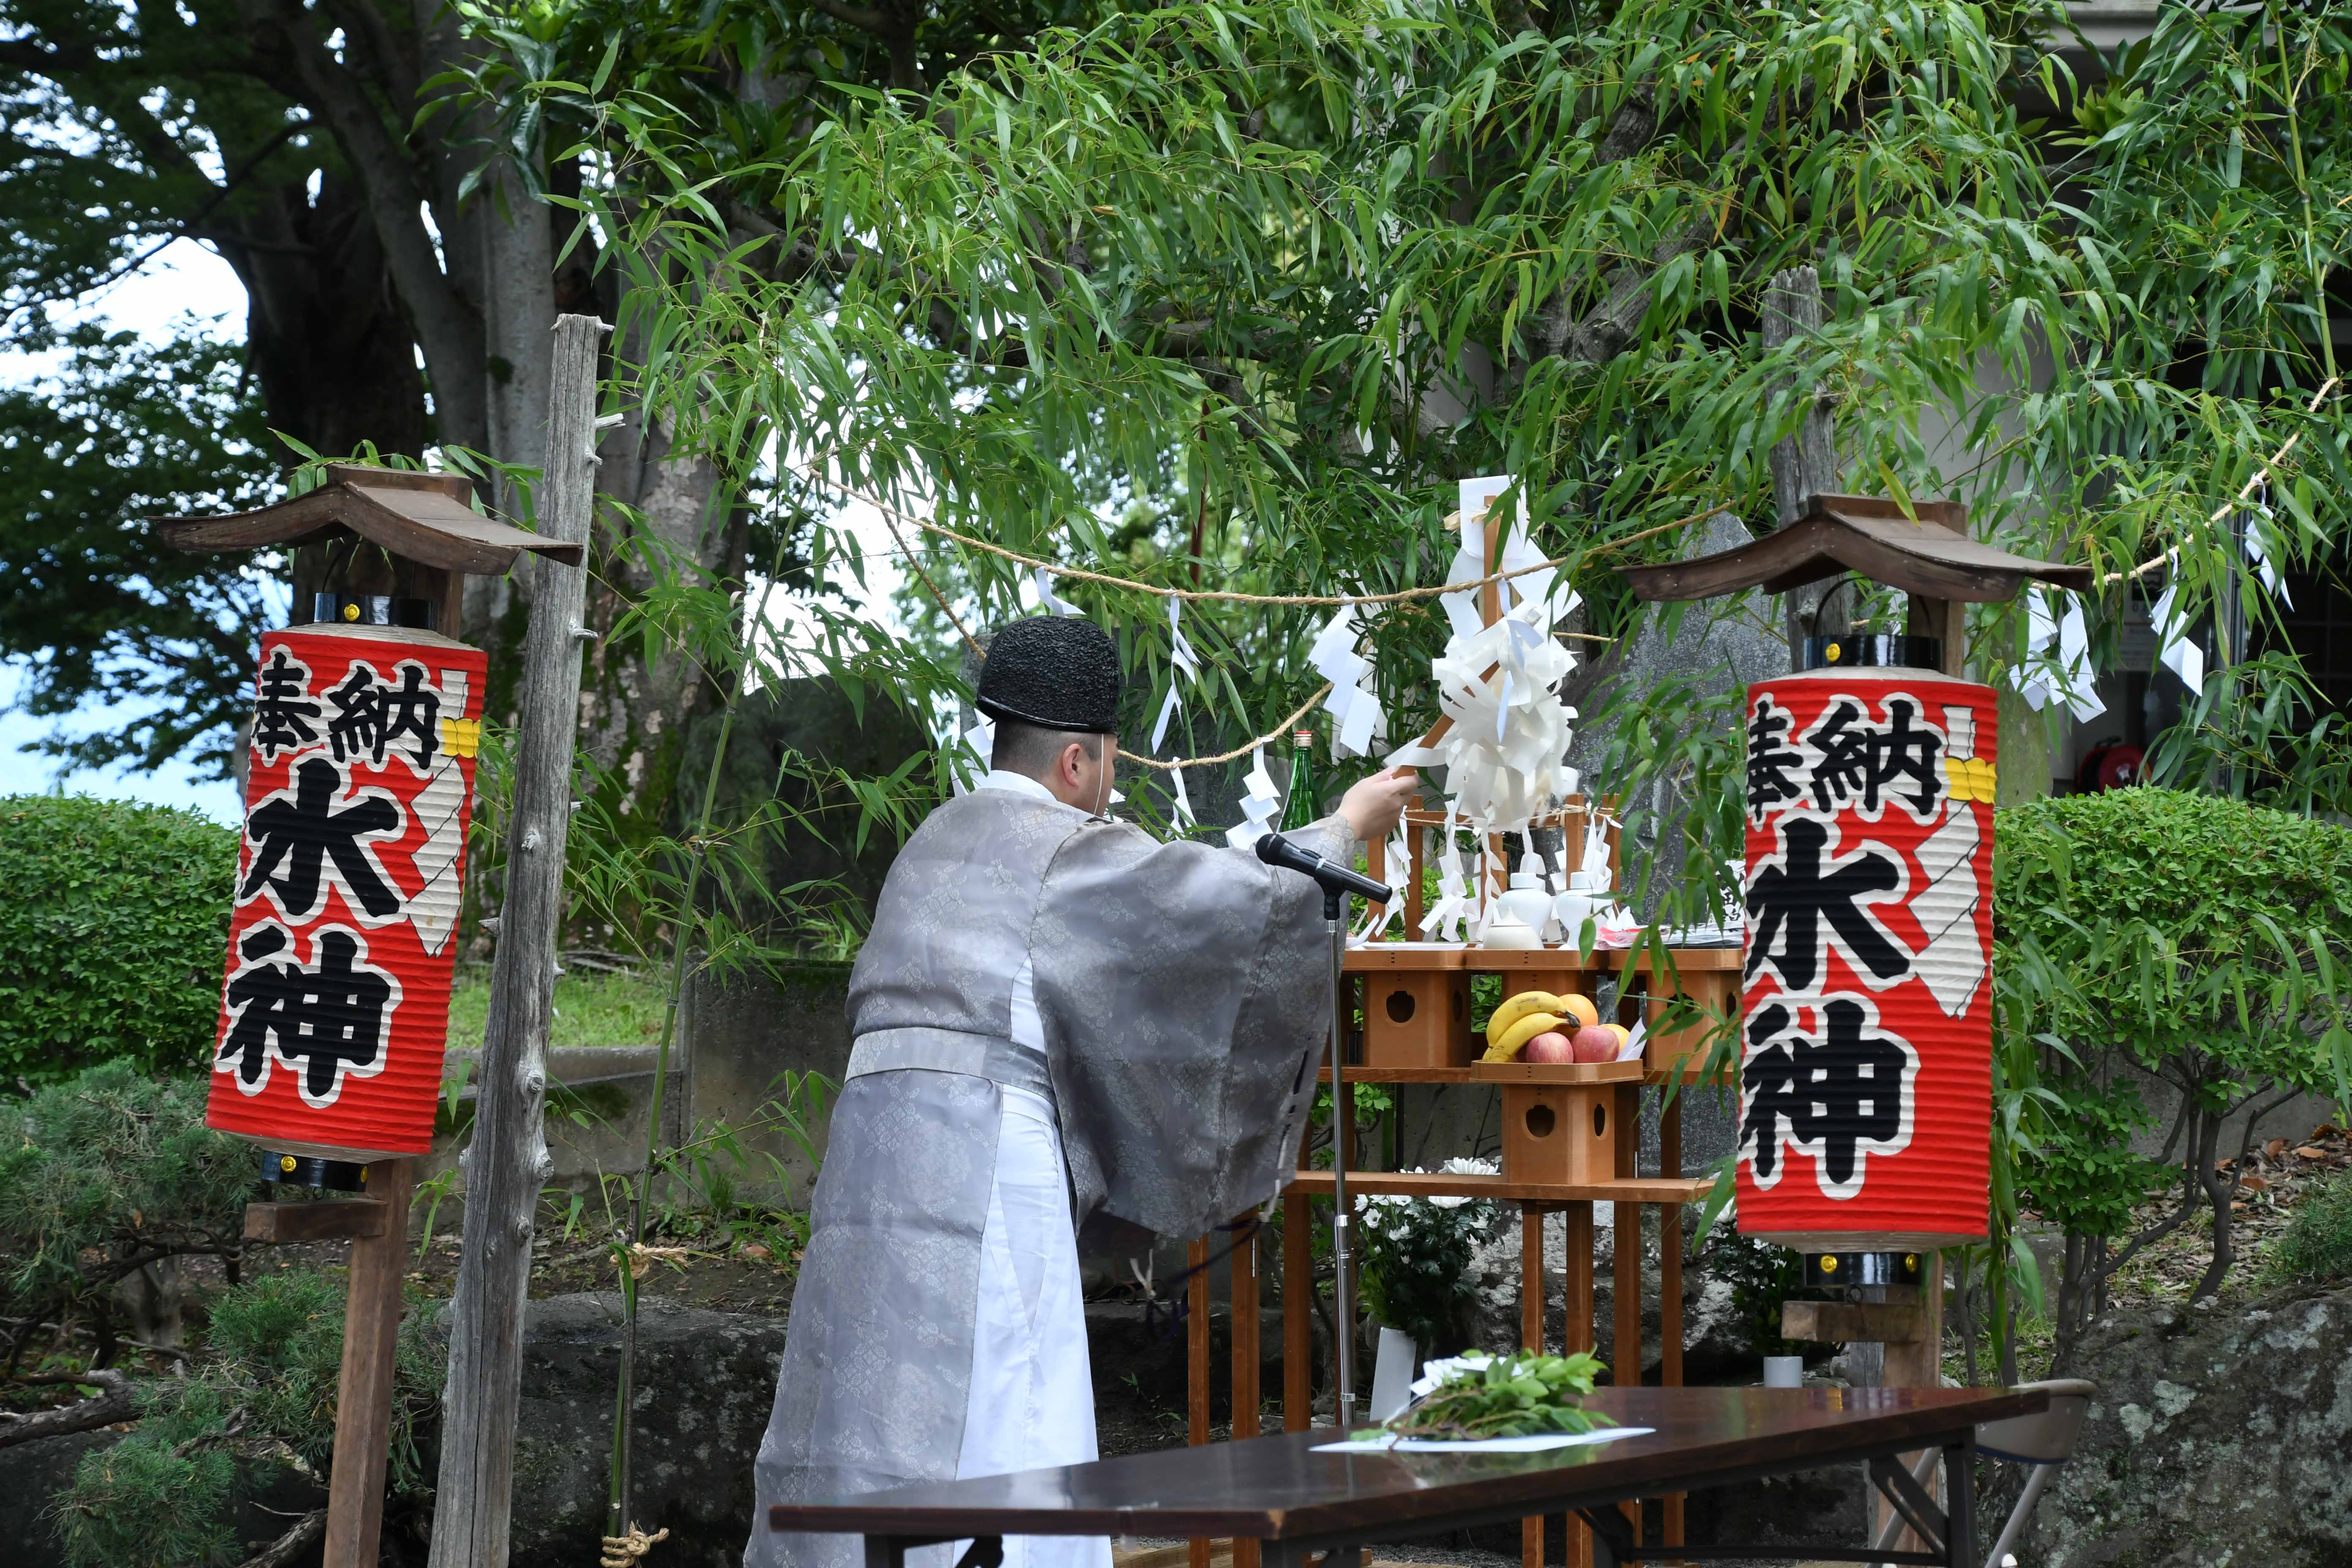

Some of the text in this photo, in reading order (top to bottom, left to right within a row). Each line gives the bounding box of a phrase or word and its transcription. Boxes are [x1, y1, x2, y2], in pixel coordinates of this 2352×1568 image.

[253, 652, 441, 770] 奉納
[219, 758, 400, 1097] 水神
[1739, 818, 1909, 1184] 水神
